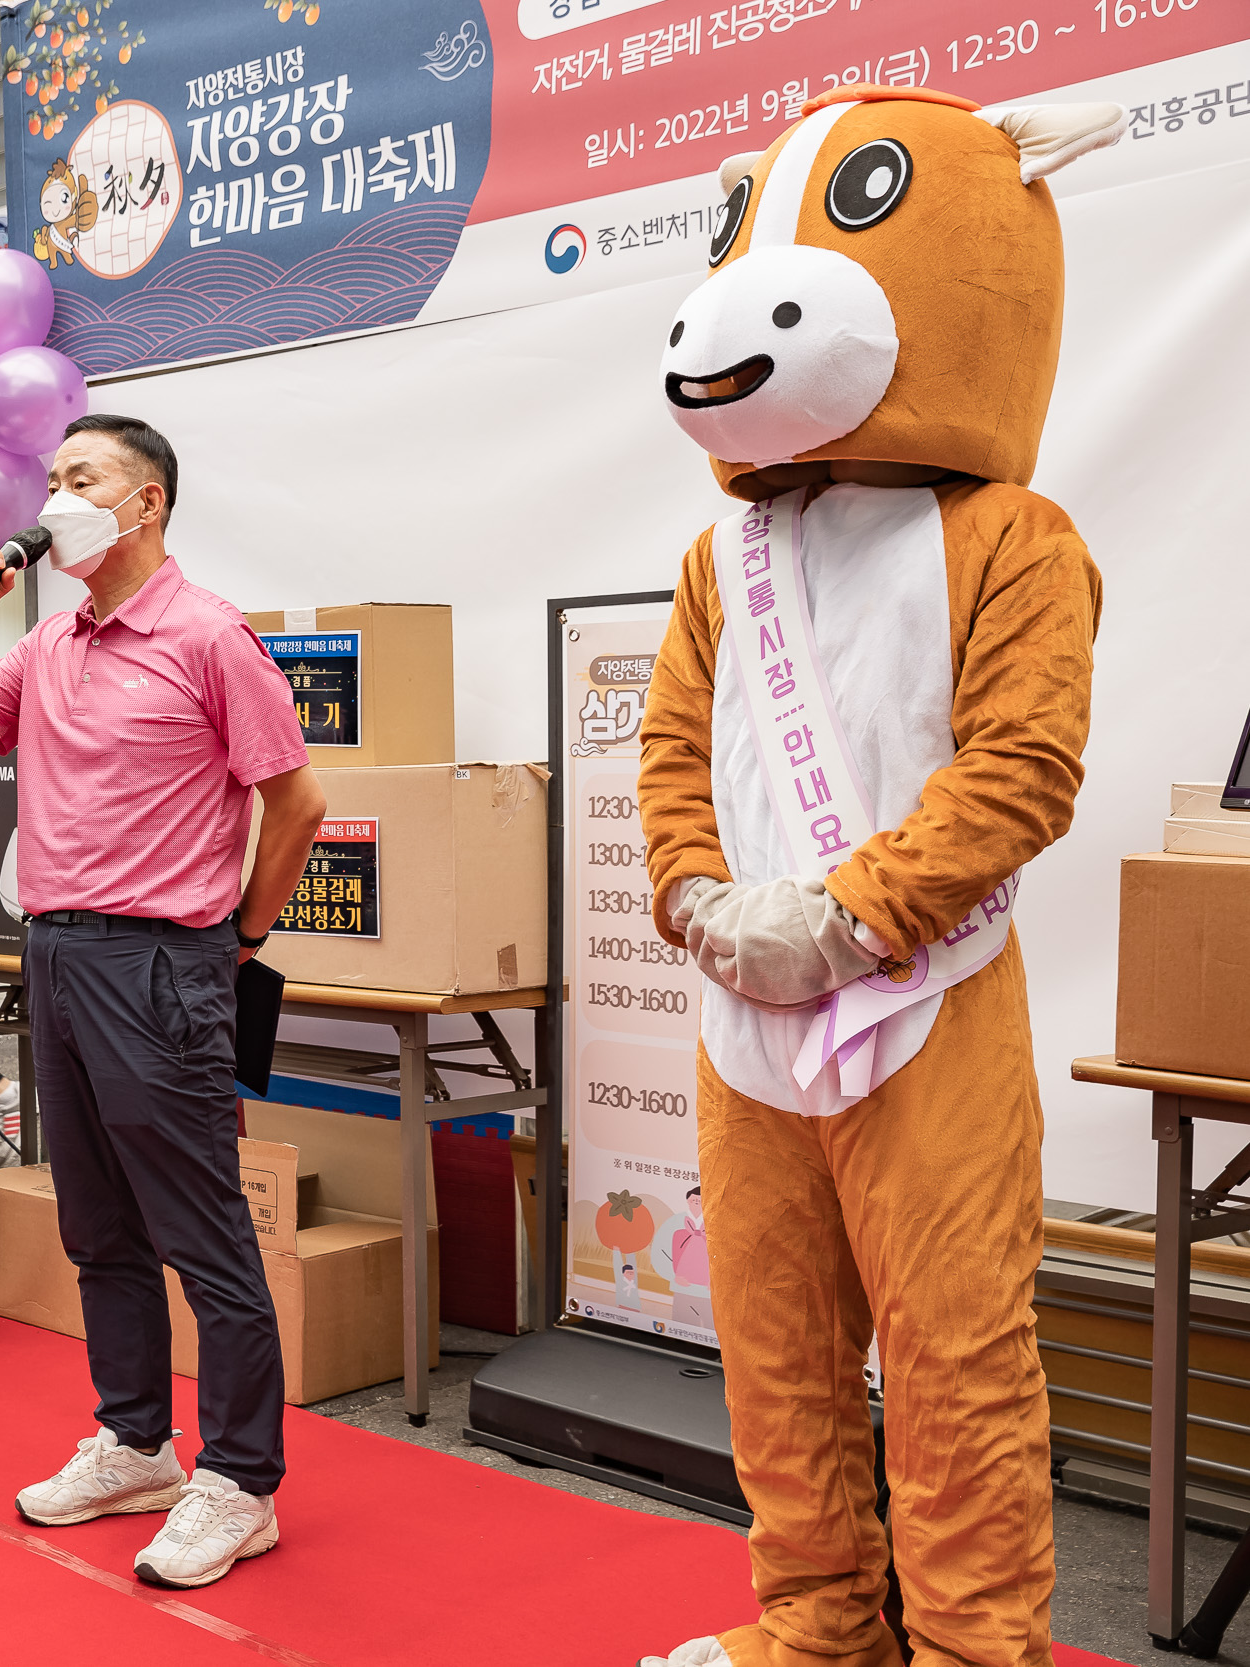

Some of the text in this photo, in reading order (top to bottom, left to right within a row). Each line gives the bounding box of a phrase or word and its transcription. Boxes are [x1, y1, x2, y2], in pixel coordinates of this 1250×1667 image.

[619, 16, 702, 75] 물걸레
[186, 45, 306, 111] 자양전통시장
[584, 122, 645, 169] 일시:
[654, 93, 750, 149] 2022년
[946, 19, 1040, 73] 12:30
[186, 74, 353, 175] 자양강장
[102, 157, 167, 215] 秋夕
[188, 121, 456, 248] 한마음 대축제
[597, 203, 725, 257] 중소벤처기
[273, 640, 302, 653] 자양강장
[303, 640, 327, 652] 한마음
[328, 639, 352, 652] 대축제
[456, 770, 468, 779] BK
[320, 823, 370, 837] 한마음 대축제
[289, 877, 362, 903] 공물걸레
[279, 905, 362, 931] 무선청소기
[588, 935, 688, 967] 14:00~15:30
[588, 982, 688, 1015] 15:30~16:00
[588, 1081, 688, 1118] 12:30~16:00
[623, 1160, 633, 1171] 위
[635, 1162, 661, 1176] 일정은
[247, 1181, 267, 1193] 16개입
[258, 1208, 271, 1219] 개입
